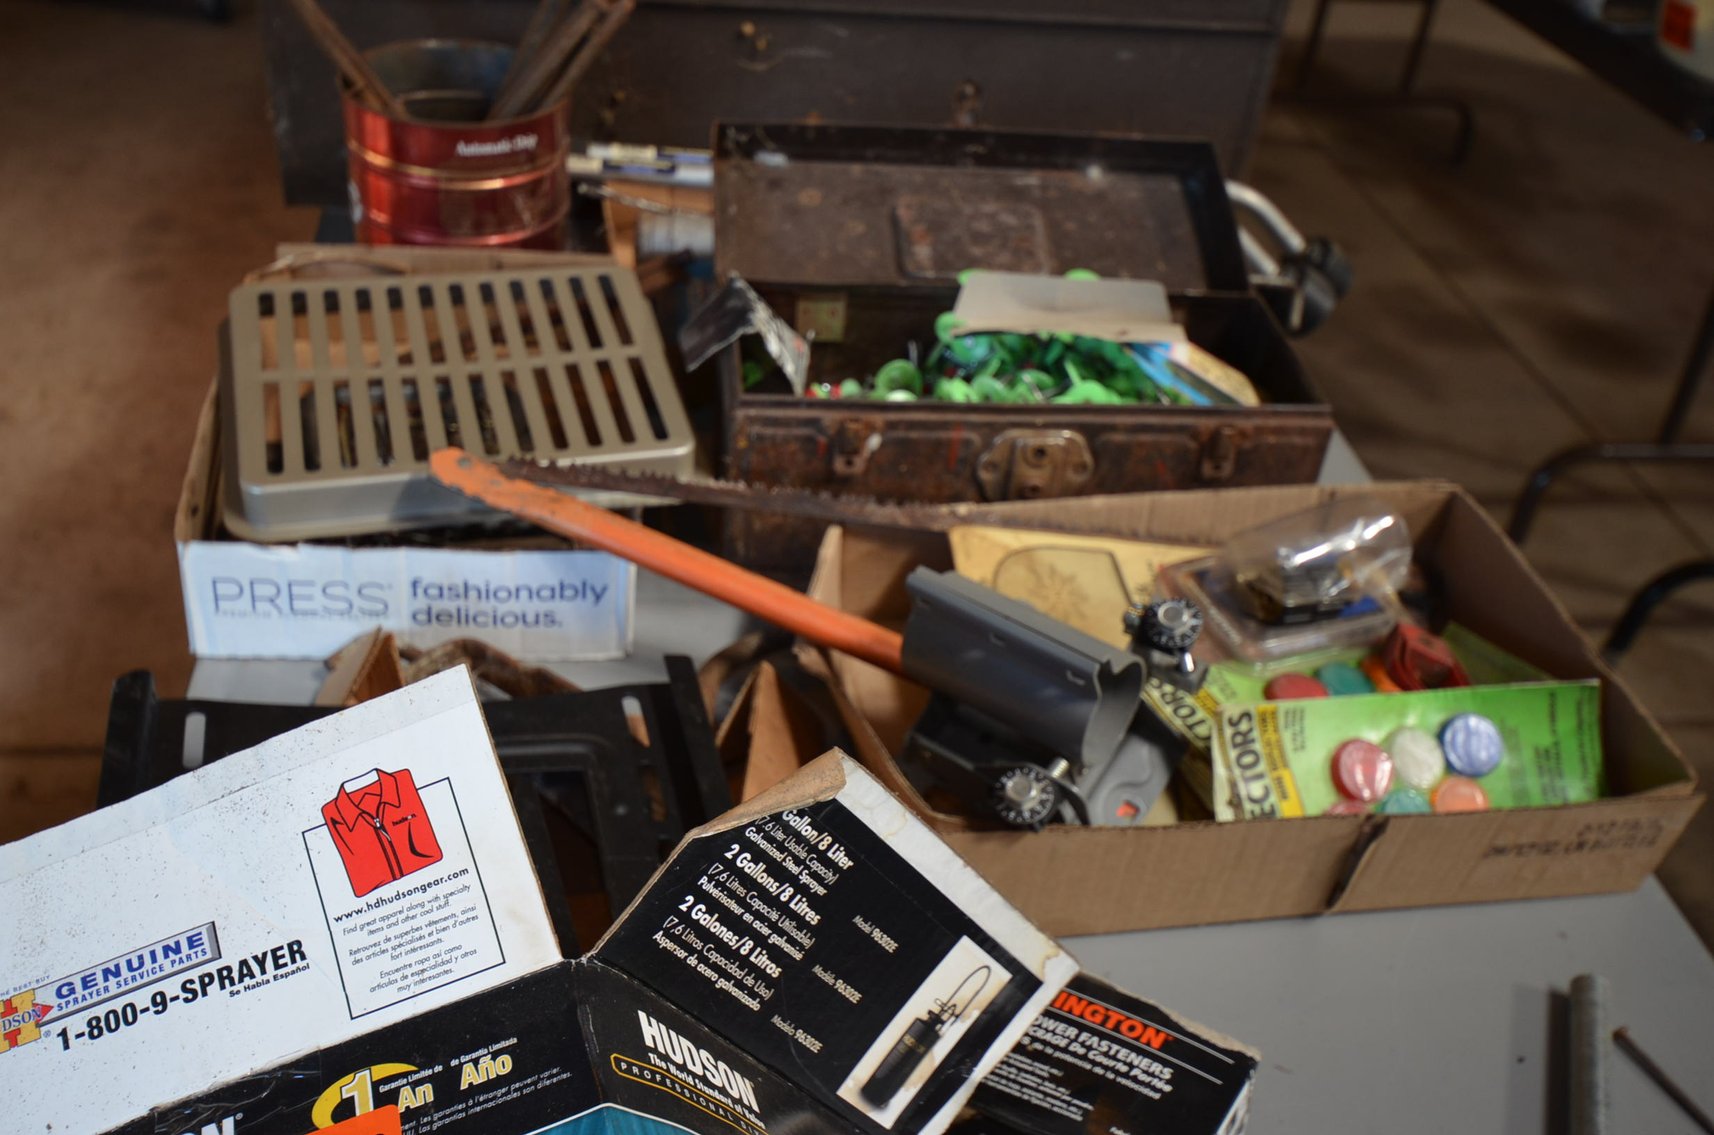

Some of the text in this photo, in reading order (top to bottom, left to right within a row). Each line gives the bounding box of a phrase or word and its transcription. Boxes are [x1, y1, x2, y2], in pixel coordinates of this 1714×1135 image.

[212, 577, 389, 616] PRESS
[411, 577, 608, 607] fashionably
[411, 604, 562, 629] delicious.
[745, 826, 828, 896] Galvanized Steel Sprayer
[771, 825, 787, 842] Liter
[784, 837, 808, 860] Usable
[806, 854, 839, 885] Capacity)
[782, 809, 854, 870] Gallon/8 Liter
[333, 868, 468, 922] www.hdhudsongear.com
[343, 884, 471, 935] Find great apparel along with specialty
[708, 862, 816, 949] (7,6 Litres Capacité Utilisable)
[724, 844, 822, 925] 2 Gallons/8 Litres
[349, 905, 476, 957] Retrouvez de superbes vêtements, ainsi
[368, 900, 451, 936] items and other cool stuff.
[678, 895, 783, 978] 2 Galones/8 Litros
[698, 875, 805, 961] Pulvérisateur en acier galvanisé
[852, 915, 876, 934] Model
[55, 931, 205, 1000] GENUINE
[352, 956, 363, 966] des
[365, 946, 389, 961] articles
[391, 933, 426, 952] spécialisés
[428, 930, 434, 938] et
[436, 924, 449, 934] bien
[380, 963, 412, 979] Encuentre
[415, 956, 431, 970] ropa
[444, 944, 462, 955] como
[390, 938, 444, 961] fort intéressants.
[401, 972, 408, 981] de
[411, 957, 453, 978] especialidad
[454, 955, 459, 964] y
[461, 949, 477, 960] otros
[662, 915, 774, 1001] (7,6 Litros Capacidad de Uso)
[13, 982, 32, 993] BEST
[35, 975, 50, 985] BUY
[56, 939, 307, 1051] 1-800-9-SPRAYER
[57, 948, 208, 1011] SPRAYER SERVICE PARTS
[229, 963, 310, 998] Se Habla Español
[397, 969, 454, 993] muy interesantes.
[653, 930, 761, 1011] Aspersor de acero galvanizado
[1, 1005, 42, 1031] DSON
[771, 1014, 795, 1036] Modelo
[450, 1057, 459, 1066] de
[489, 1036, 518, 1052] Limitada
[459, 1054, 513, 1091] Año
[638, 1010, 760, 1114] HUDSON
[1028, 1026, 1070, 1047] CRAGE
[1087, 1050, 1129, 1073] Courte
[1033, 1015, 1079, 1040] OWER
[1078, 1032, 1174, 1080] FASTENERS
[1052, 1050, 1093, 1071] potencia
[340, 1068, 374, 1117] 1
[379, 1064, 443, 1093] Garantie Limitée de
[398, 1082, 434, 1113] An
[419, 1123, 431, 1134] Las
[468, 1091, 521, 1116] internacionales
[522, 1087, 535, 1095] son
[536, 1072, 573, 1090] diferentes.
[420, 1116, 431, 1124] Les
[433, 1102, 466, 1123] garanties
[510, 1074, 538, 1092] peuvent
[540, 1066, 562, 1079] varier.
[621, 1062, 733, 1120] PROFESSIONAL
[648, 1053, 667, 1070] The
[668, 1063, 695, 1086] World
[696, 1078, 733, 1108] Standard
[734, 1105, 745, 1116] of
